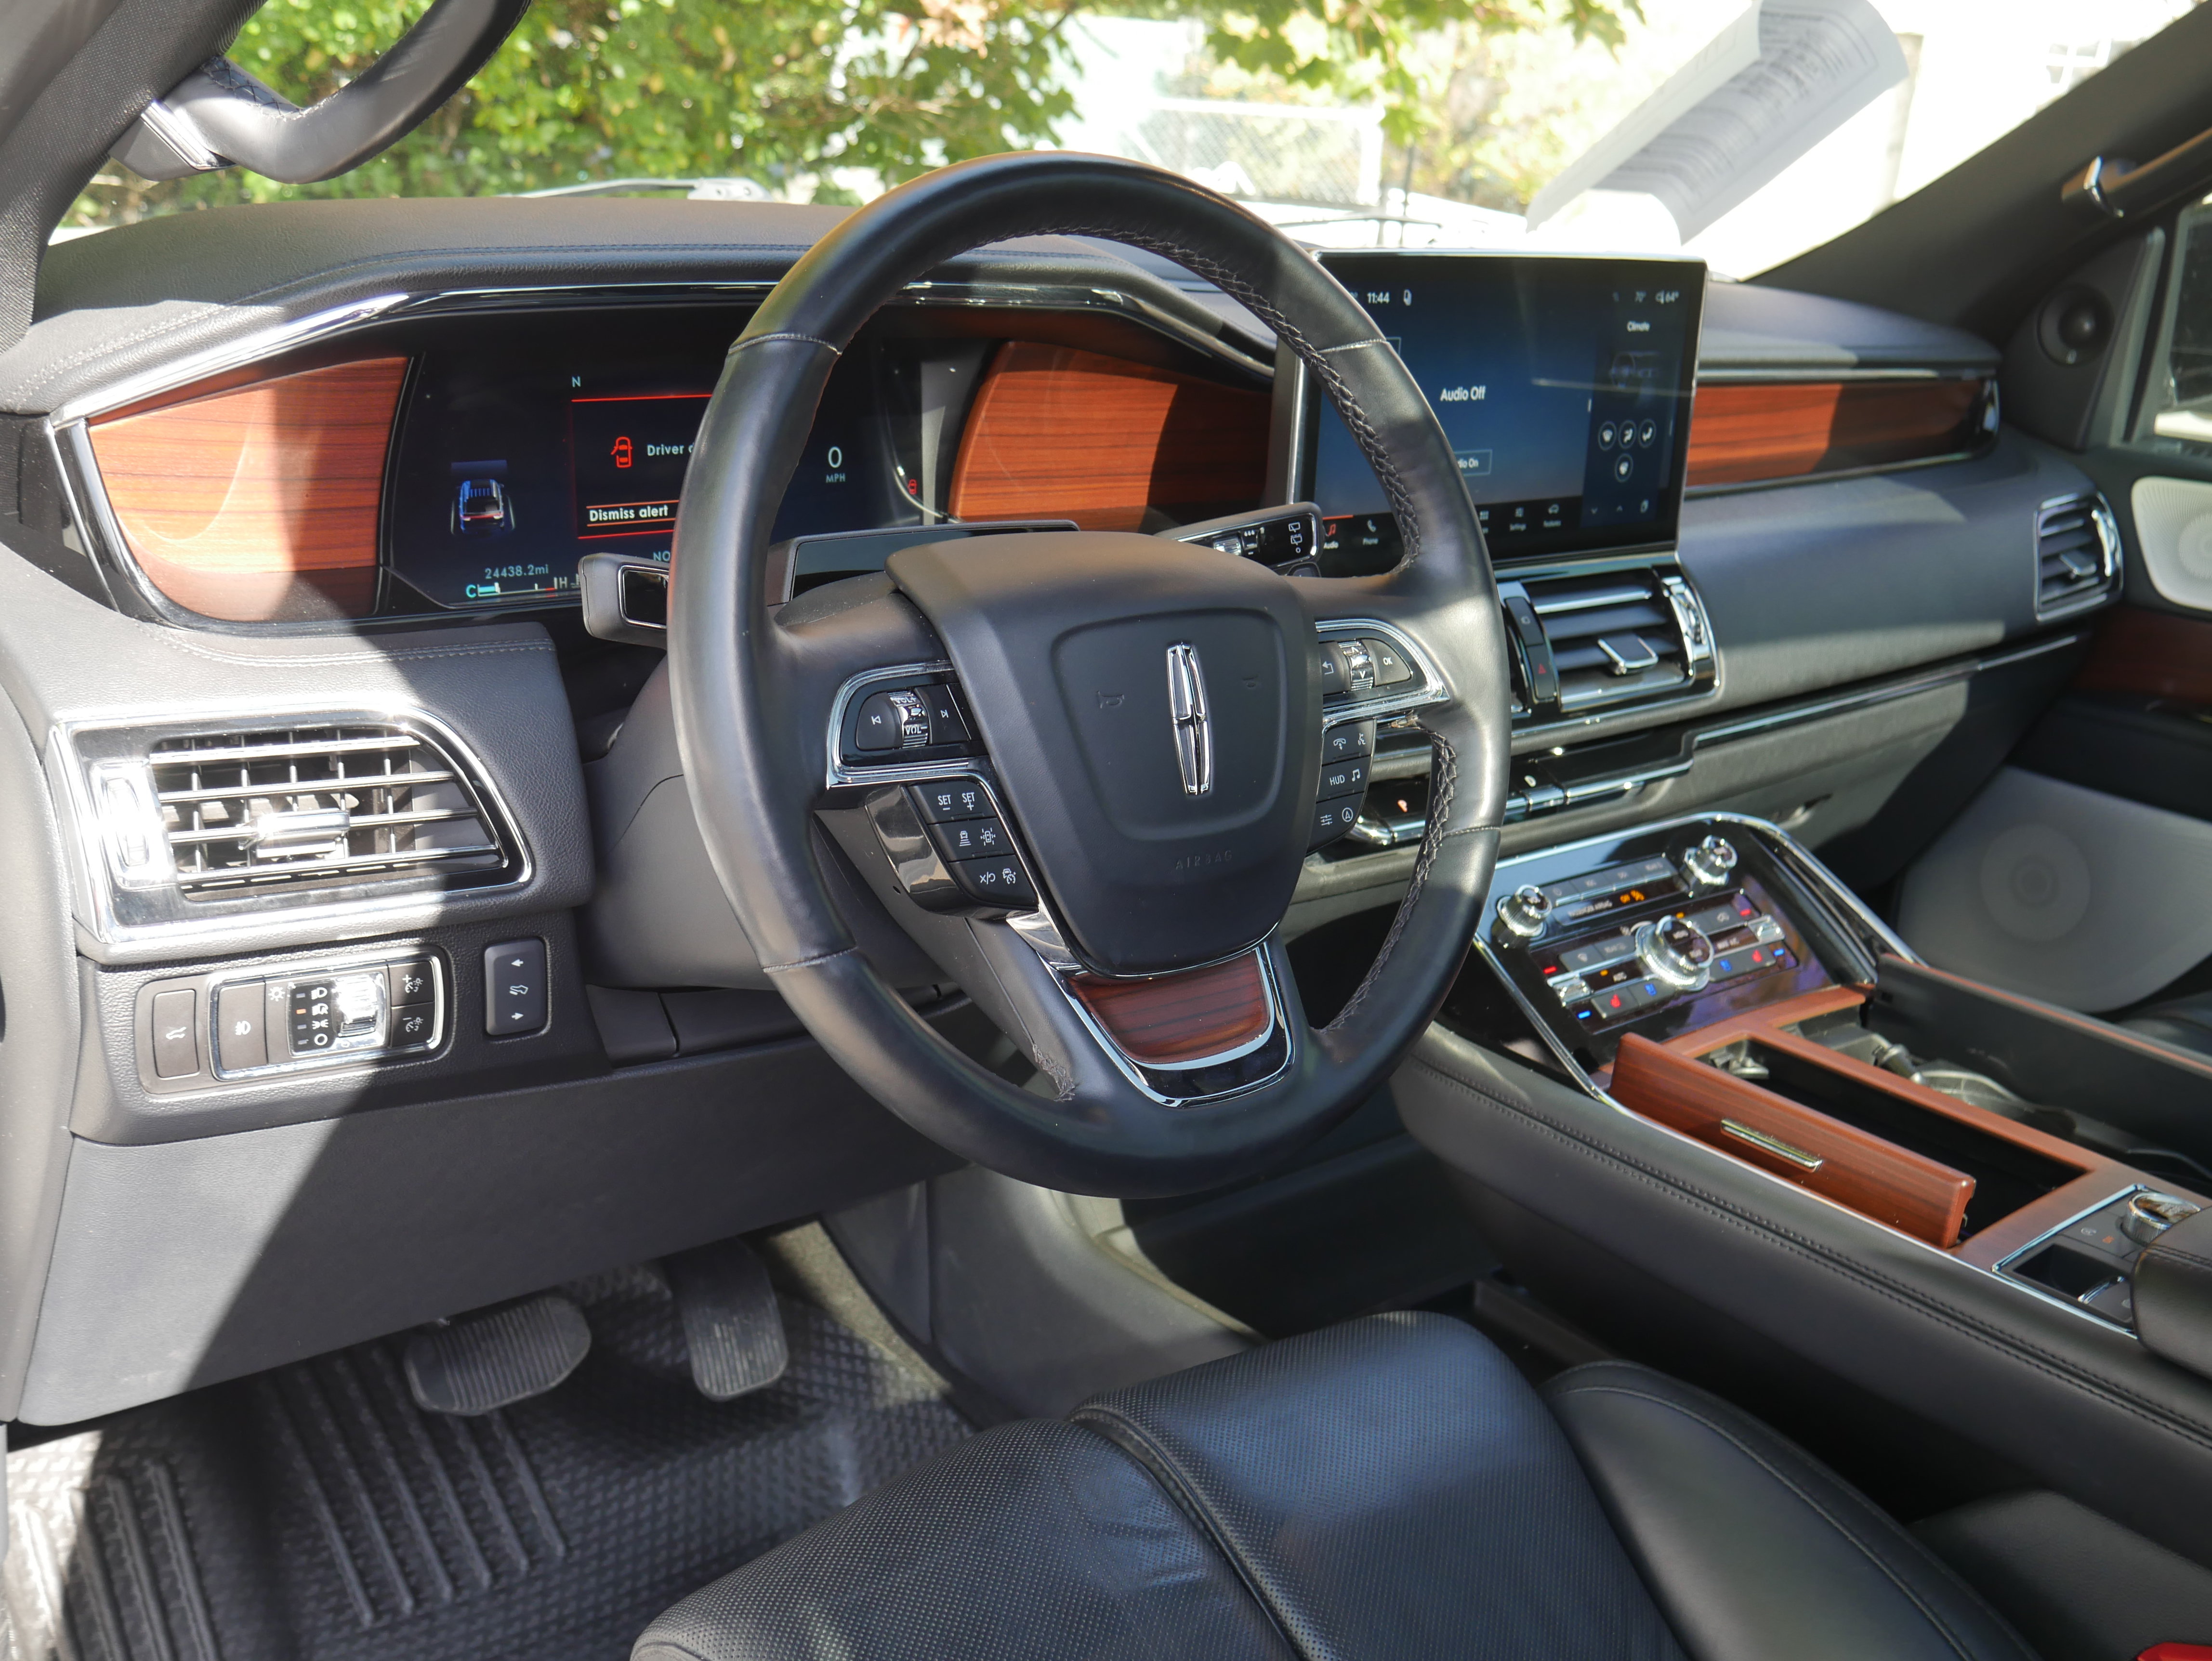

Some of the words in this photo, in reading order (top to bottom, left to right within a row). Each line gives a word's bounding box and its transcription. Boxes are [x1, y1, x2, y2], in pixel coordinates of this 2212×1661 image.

[1367, 292, 1390, 303] 11:44
[1627, 320, 1650, 331] Climate
[572, 376, 581, 387] N
[1440, 387, 1469, 401] Audio
[1470, 385, 1486, 400] Off
[647, 444, 685, 456] Driver
[828, 446, 843, 468] 0
[1469, 458, 1479, 468] On
[826, 473, 846, 483] MPH
[590, 507, 635, 522] Dismiss
[639, 504, 669, 518] alert
[1324, 540, 1339, 549] Audio
[485, 564, 549, 579] 24438.2mi
[466, 584, 477, 598] C
[1383, 657, 1393, 665] OK
[1330, 774, 1345, 786] HUD
[937, 794, 951, 805] SET
[962, 791, 975, 803] SET
[1175, 850, 1233, 870] AIRBAG
